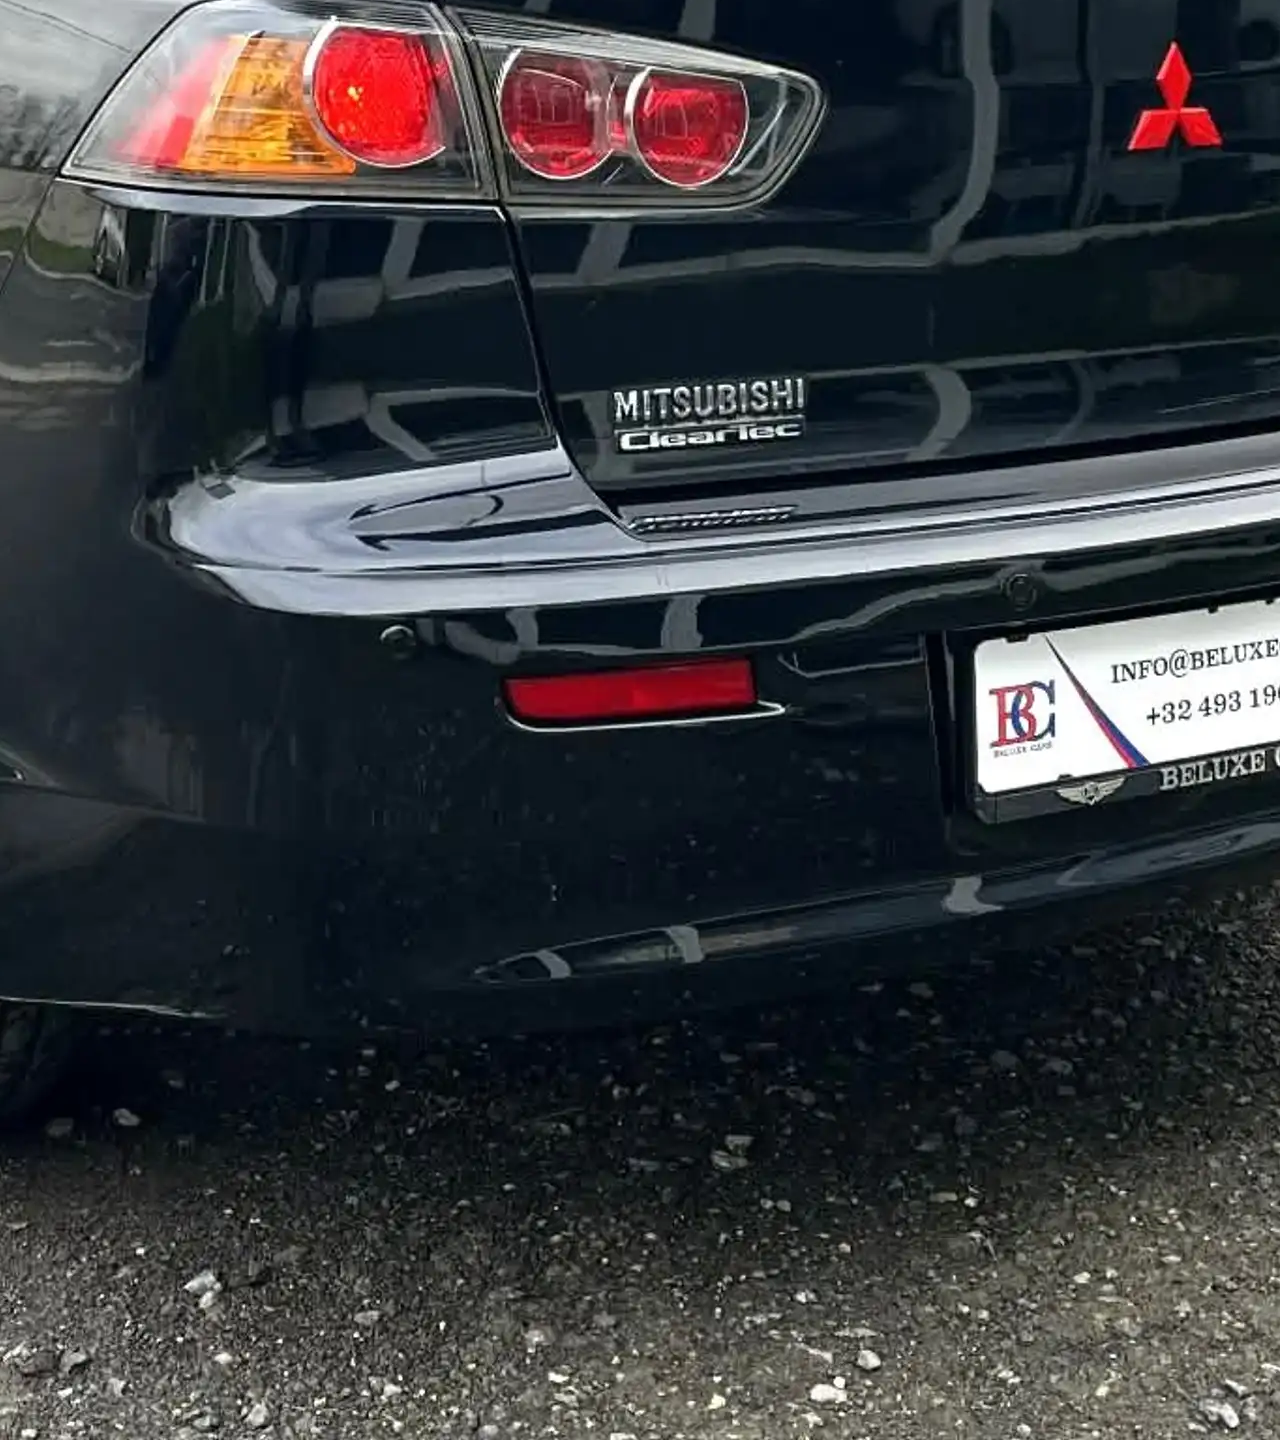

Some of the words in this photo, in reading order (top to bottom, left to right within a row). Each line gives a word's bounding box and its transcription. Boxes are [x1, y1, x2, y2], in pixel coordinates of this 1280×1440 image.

[613, 378, 805, 422] MITSUBISHI
[620, 423, 803, 451] ClearTec
[1146, 699, 1192, 725] +32
[1197, 690, 1242, 718] 493
[1159, 750, 1266, 791] BELUXE
